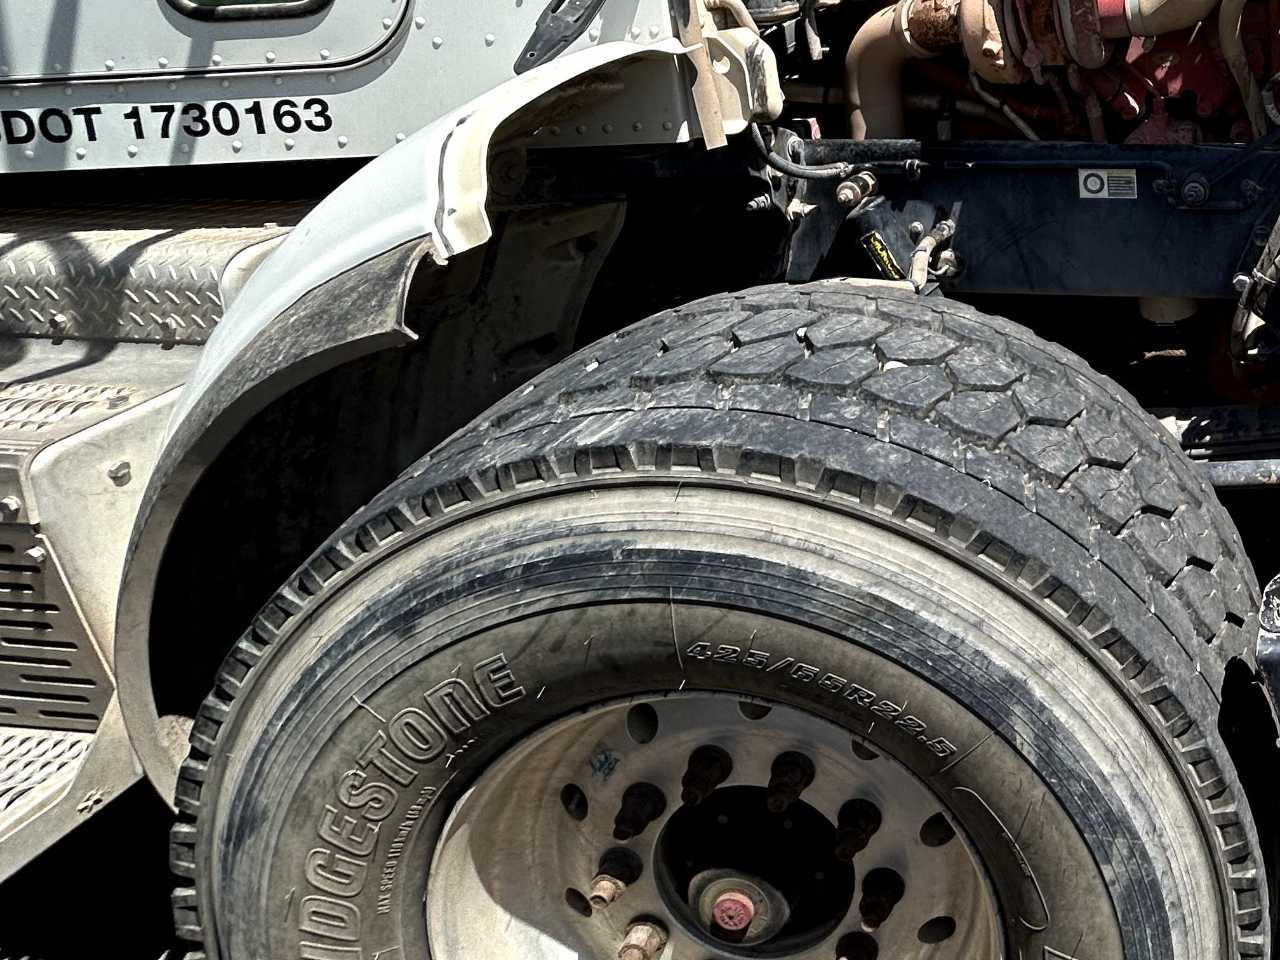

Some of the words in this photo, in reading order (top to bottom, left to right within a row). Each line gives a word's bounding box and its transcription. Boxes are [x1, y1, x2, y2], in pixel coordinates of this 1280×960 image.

[0, 107, 101, 145] DOT
[124, 98, 333, 140] 1730163
[686, 641, 958, 758] 425/65R22.5
